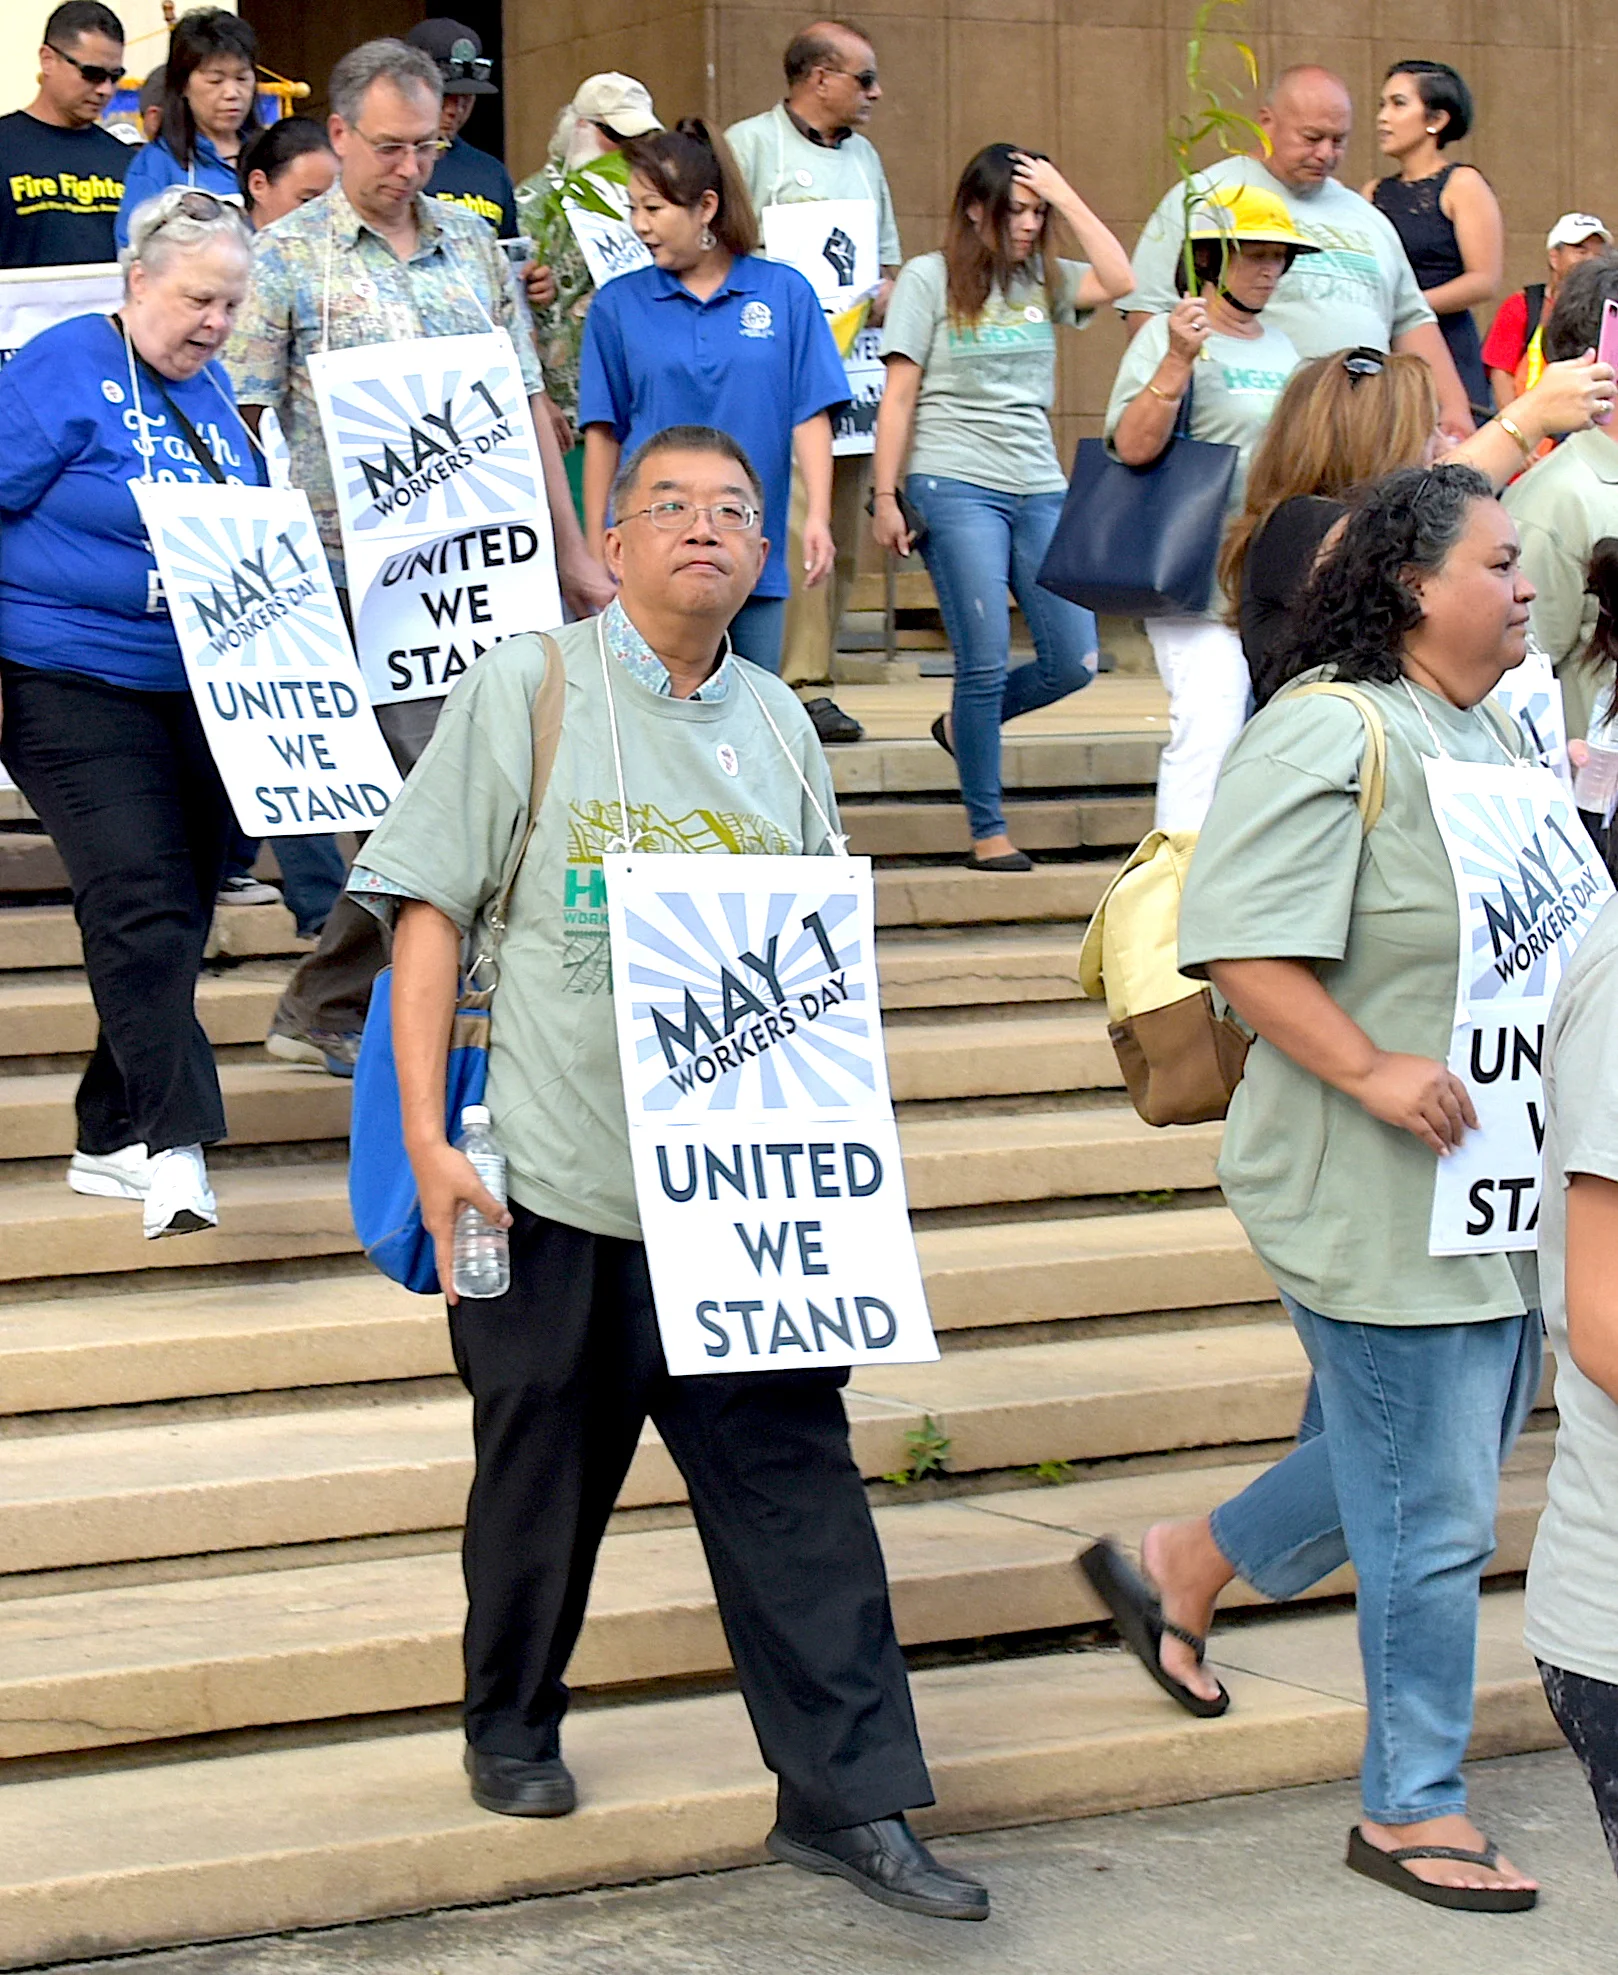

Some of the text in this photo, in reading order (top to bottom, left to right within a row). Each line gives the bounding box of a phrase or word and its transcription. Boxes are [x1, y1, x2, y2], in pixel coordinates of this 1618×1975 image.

[9, 174, 58, 202] Fire
[358, 380, 504, 499] MAY 1
[373, 419, 513, 517] WORKERS DAY
[190, 547, 276, 637] MAY
[276, 532, 307, 573] 1
[382, 525, 539, 588] UNITED
[209, 574, 318, 656] WORKERS DAY
[420, 584, 493, 629] WE
[387, 631, 525, 691] STA
[207, 681, 358, 721] UNITED
[267, 733, 338, 770] WE
[255, 783, 393, 824] STAND
[1481, 813, 1585, 959] MAY 1
[1494, 866, 1600, 985] WORKERS DAY
[650, 911, 841, 1069] MAY 1
[668, 971, 849, 1096] WORKERS DAY
[655, 1142, 884, 1204] UNITED
[733, 1221, 831, 1278] WE
[695, 1296, 897, 1358] STAND
